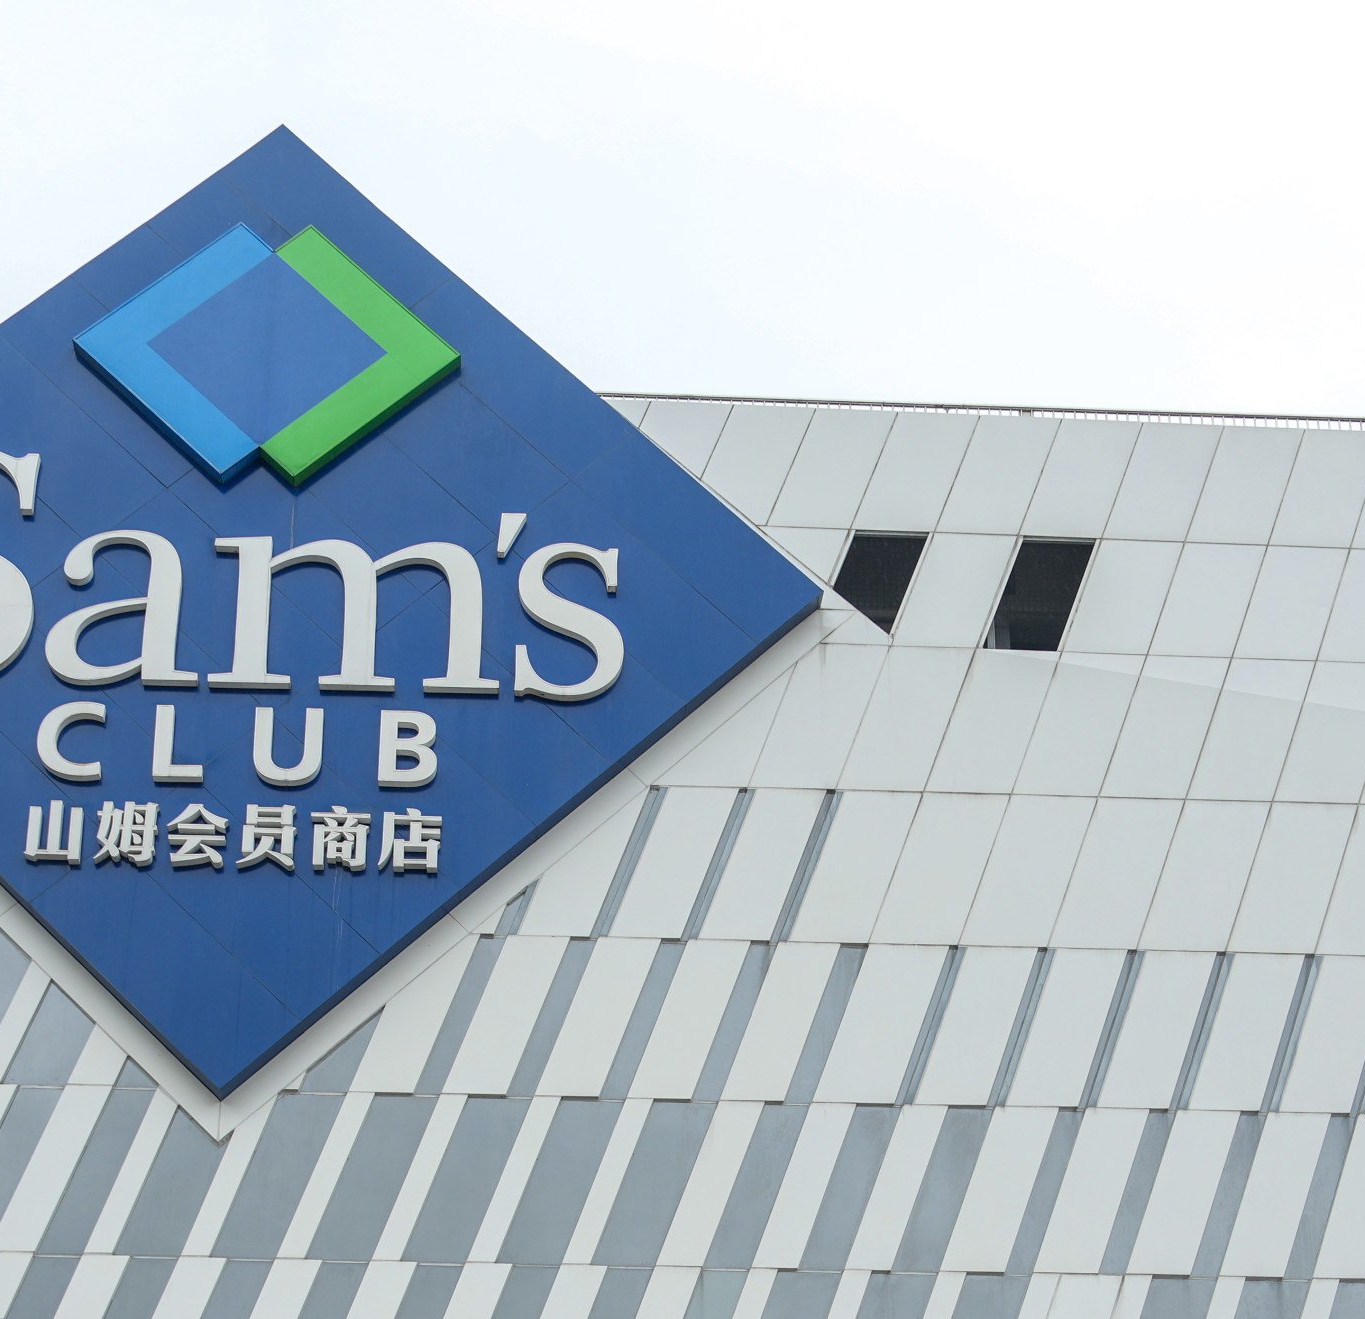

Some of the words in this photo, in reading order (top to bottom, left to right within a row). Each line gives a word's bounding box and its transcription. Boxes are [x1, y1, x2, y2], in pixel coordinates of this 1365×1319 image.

[36, 700, 438, 788] CLUB
[23, 800, 443, 874] 山姆会员商店
